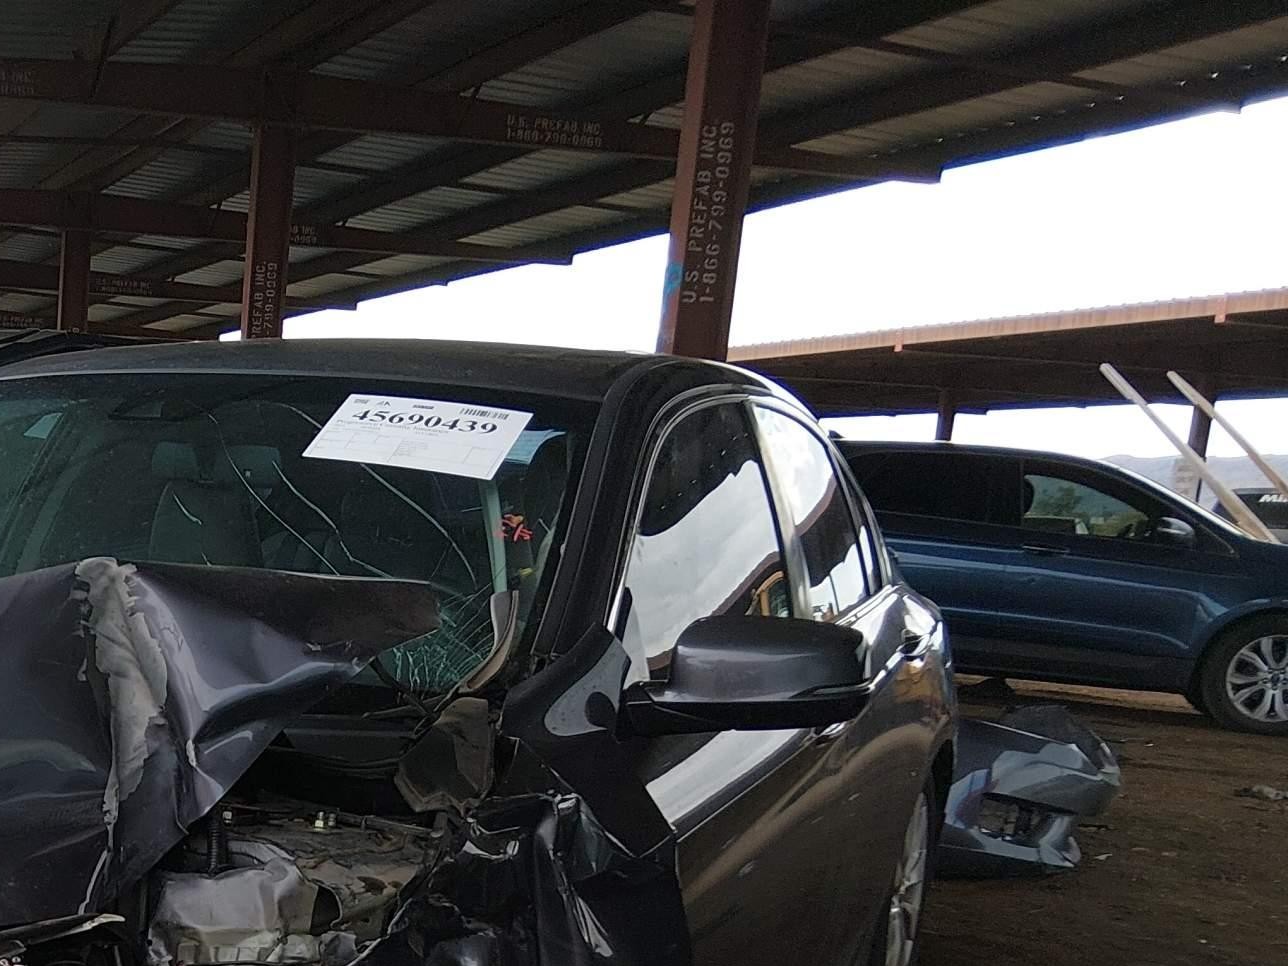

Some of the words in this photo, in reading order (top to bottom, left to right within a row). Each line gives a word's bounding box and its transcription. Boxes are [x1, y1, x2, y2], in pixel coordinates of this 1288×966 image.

[687, 170, 712, 252] PREFAB
[699, 121, 735, 303] 1-866-799-0969
[681, 264, 701, 304] U.S.
[251, 292, 265, 338] REFAB
[352, 409, 498, 435] 45690439
